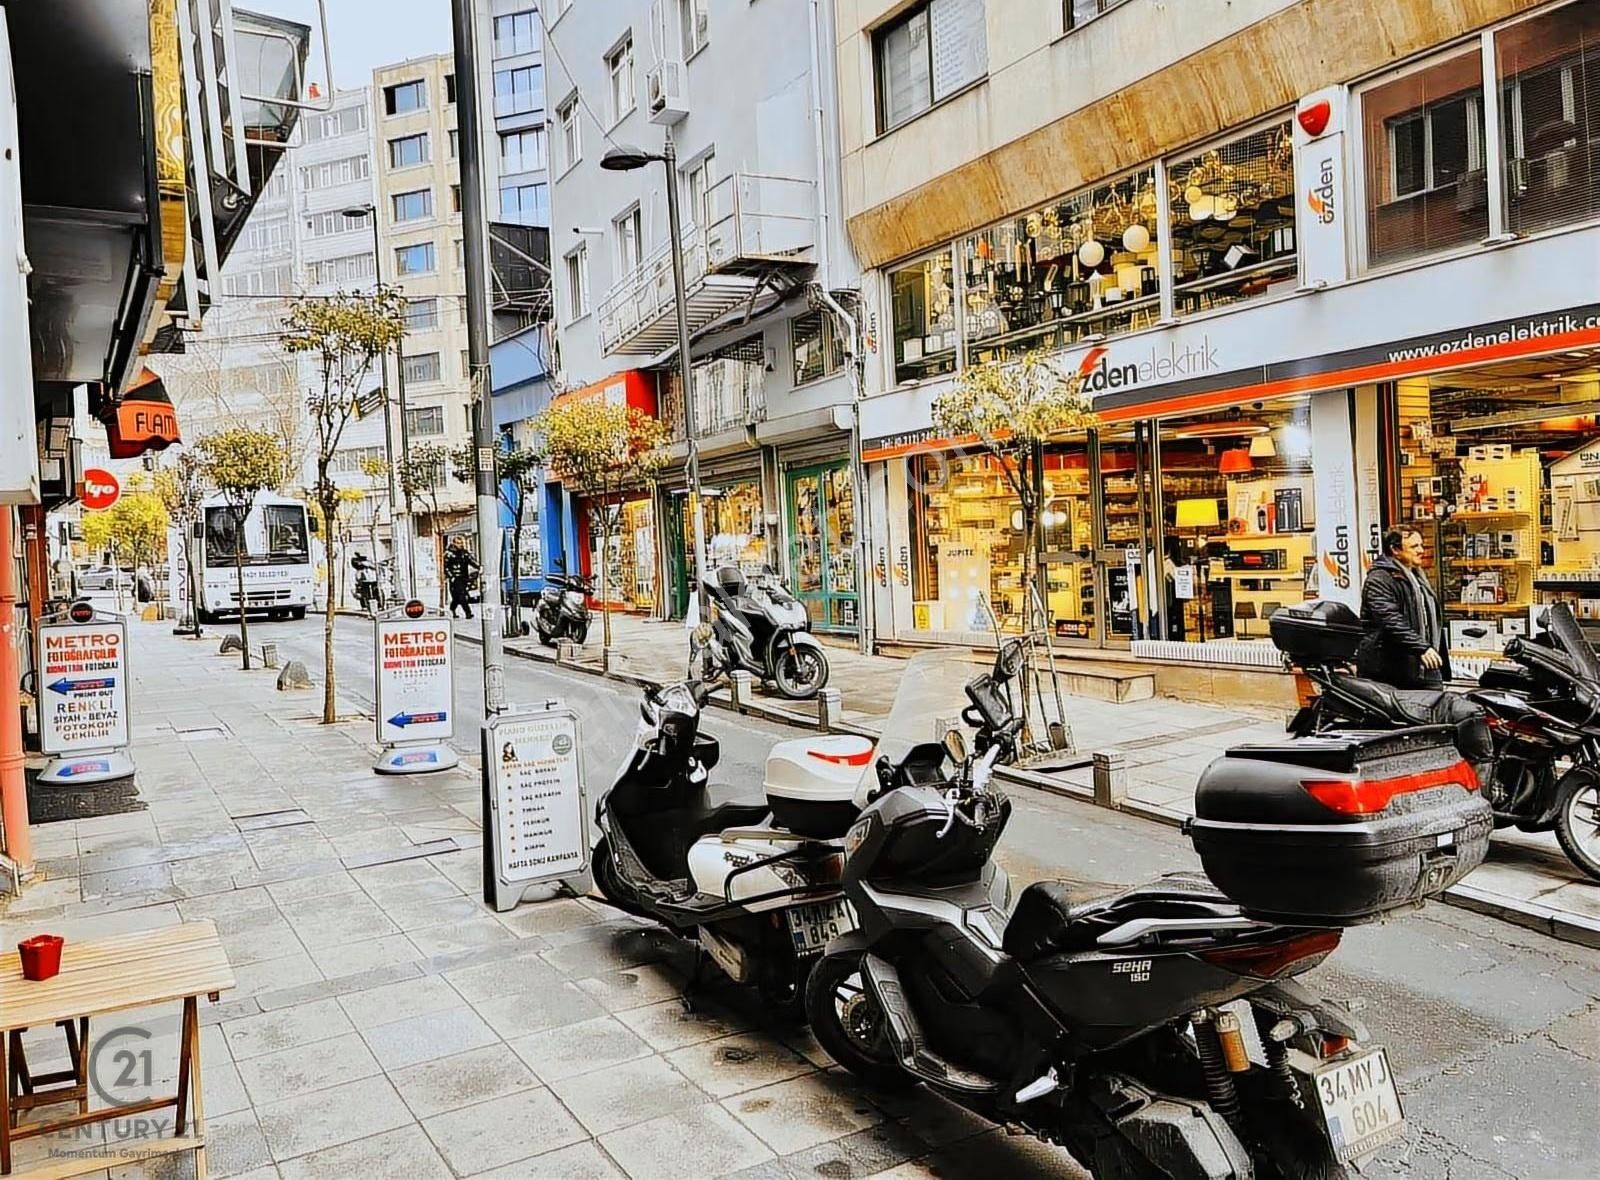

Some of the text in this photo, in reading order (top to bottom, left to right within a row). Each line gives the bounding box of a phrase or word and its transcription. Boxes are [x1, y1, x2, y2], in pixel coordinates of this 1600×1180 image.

[1314, 157, 1335, 224] özden
[1067, 334, 1219, 393] zdenelektrik
[46, 633, 120, 649] METRO
[384, 631, 447, 646] METRO
[810, 922, 839, 944] 849
[1131, 972, 1150, 982] 150
[1321, 1071, 1347, 1106] 34
[1352, 1095, 1389, 1135] 604
